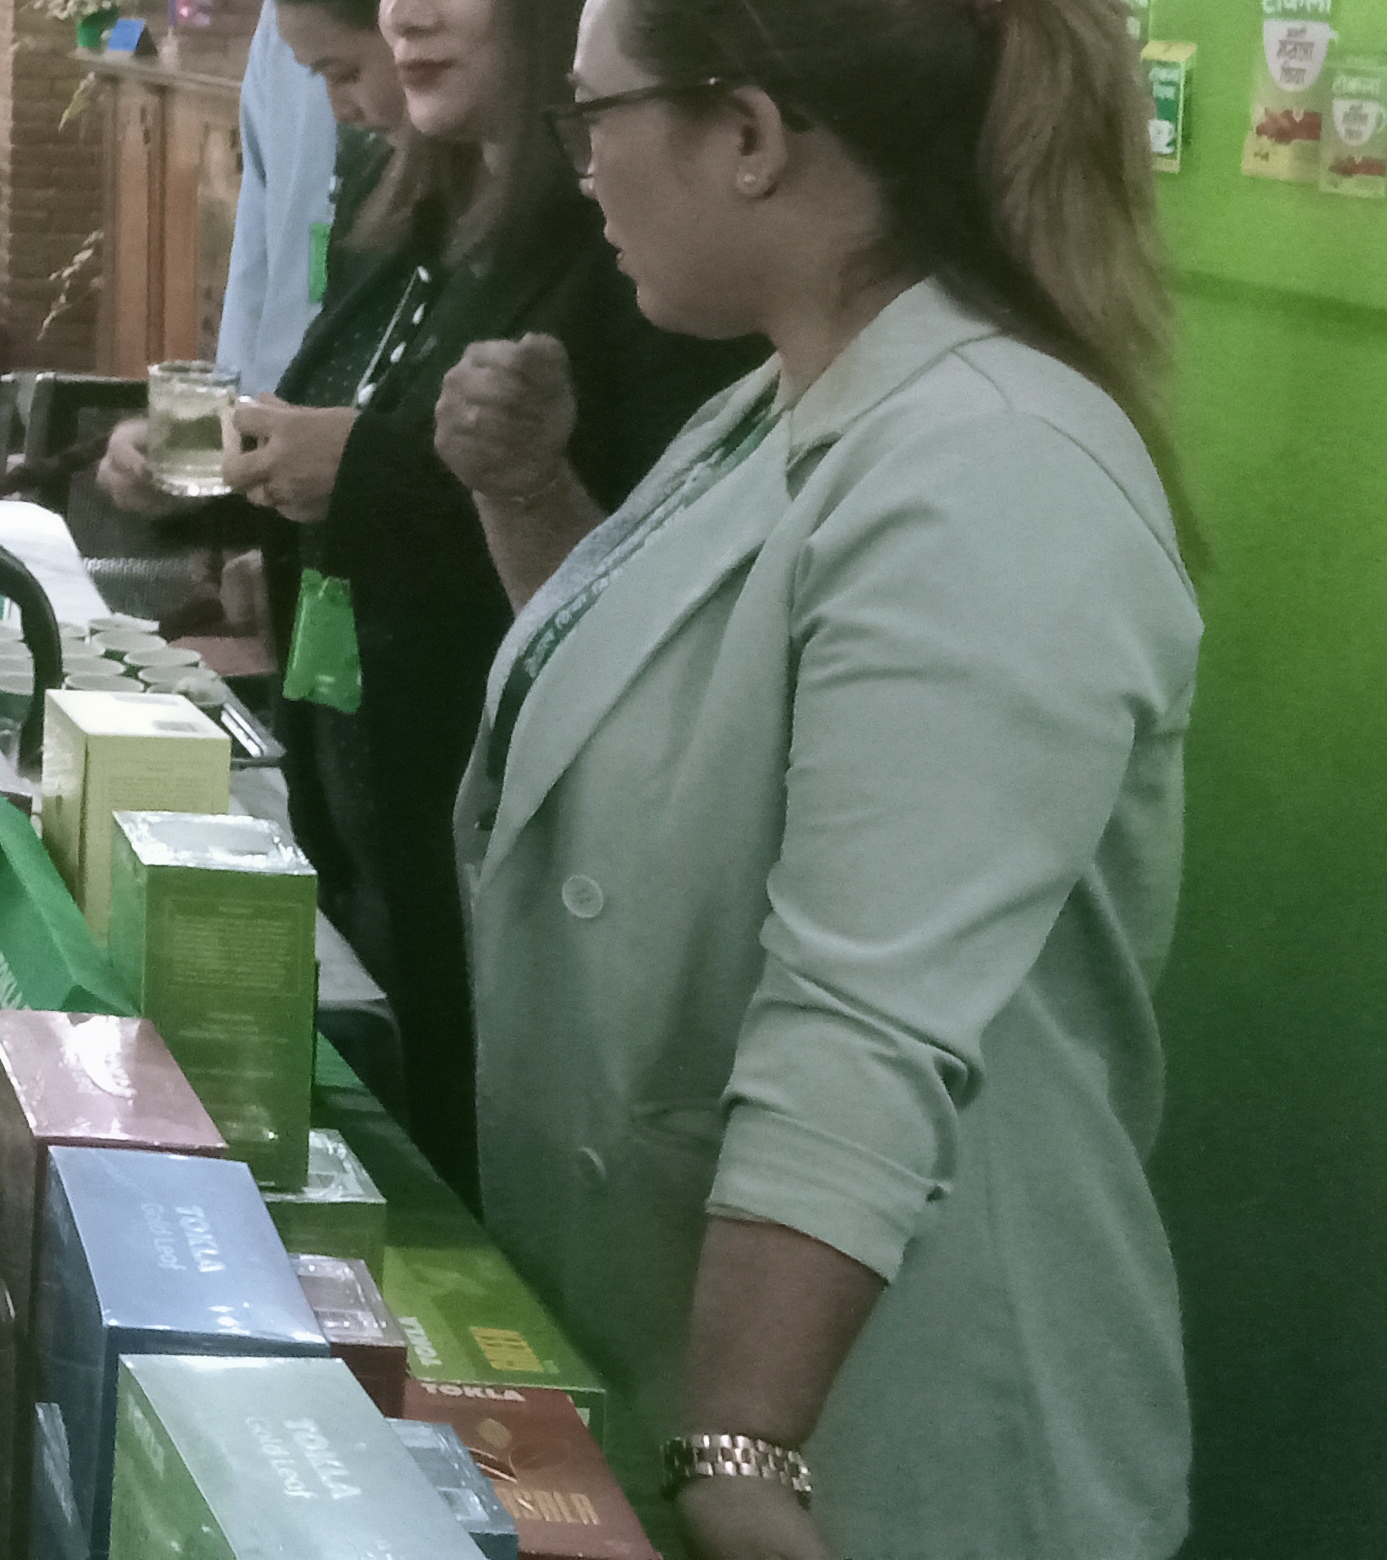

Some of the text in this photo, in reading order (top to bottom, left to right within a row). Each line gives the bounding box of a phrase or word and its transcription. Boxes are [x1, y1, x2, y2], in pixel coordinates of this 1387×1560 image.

[154, 1238, 186, 1270] Leaf
[175, 1205, 226, 1272] TOKLA
[421, 1383, 526, 1402] TOKLA
[270, 1458, 318, 1498] Leaf
[283, 1418, 362, 1500] TOKLA
